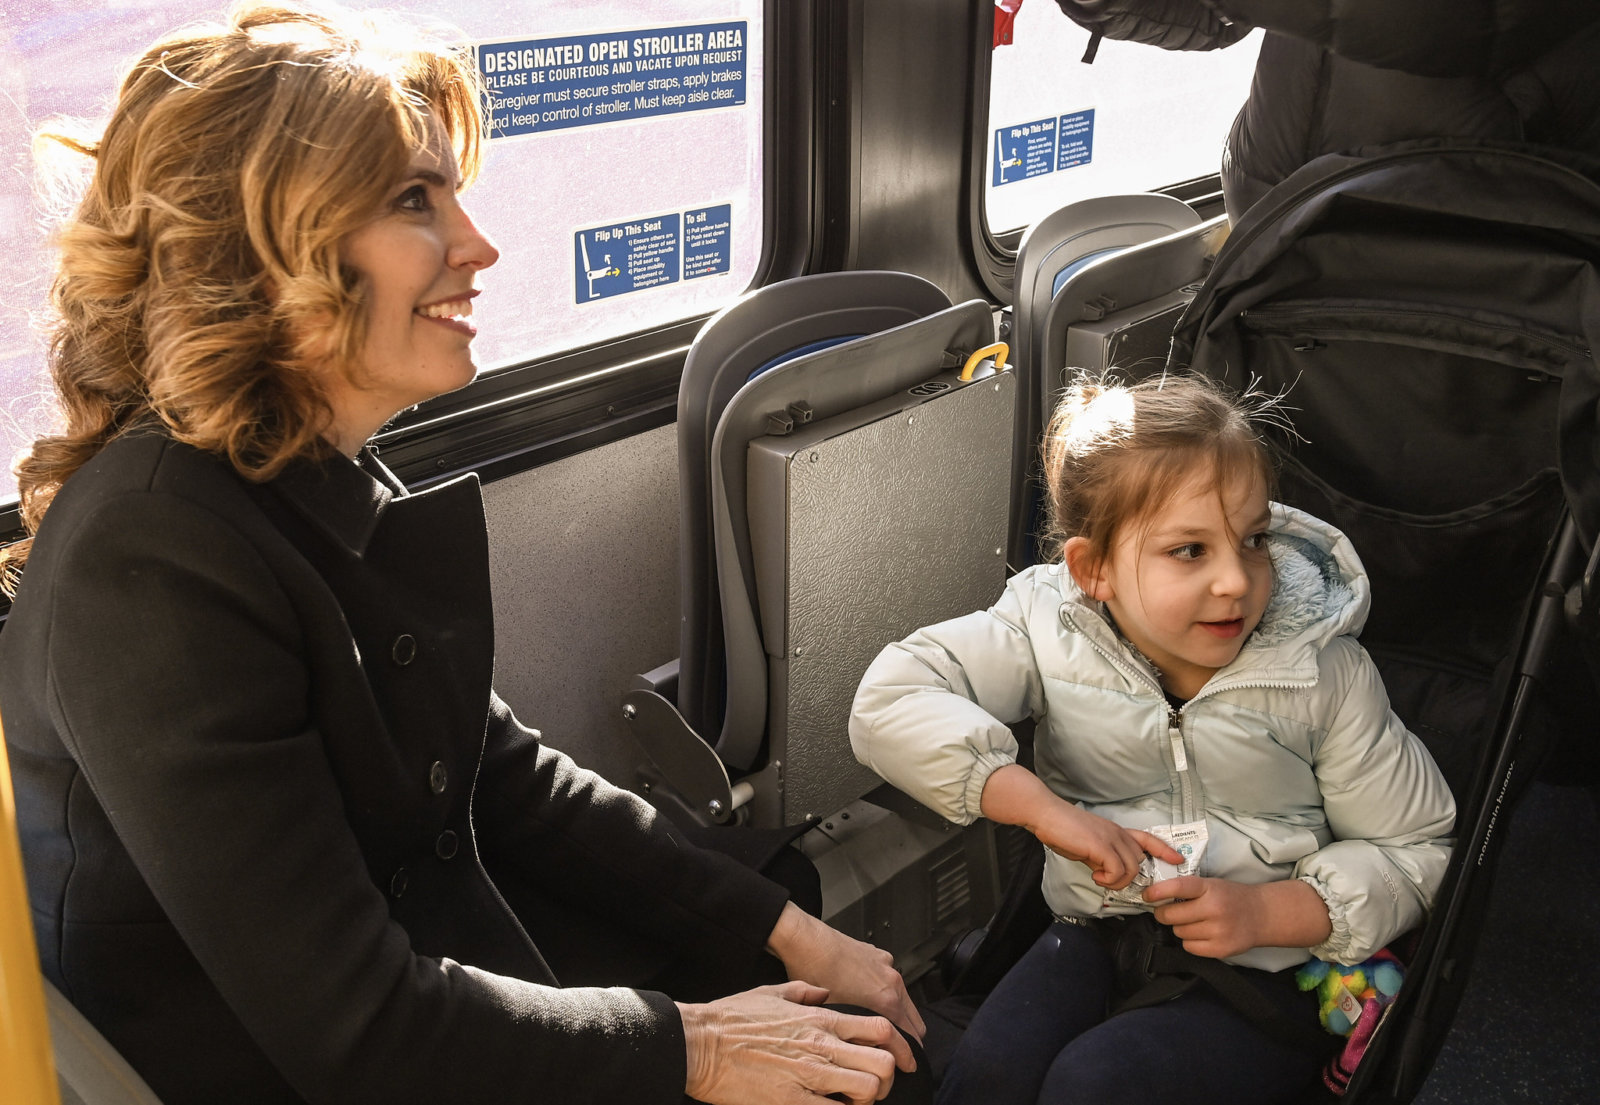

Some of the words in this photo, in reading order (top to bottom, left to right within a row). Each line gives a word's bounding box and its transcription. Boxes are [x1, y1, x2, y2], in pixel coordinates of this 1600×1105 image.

[485, 45, 583, 73] DESIGNATED
[589, 40, 628, 62] OPEN
[633, 33, 703, 57] STROLLER
[707, 29, 743, 50] AREA
[486, 73, 528, 89] PLEASE
[531, 71, 545, 84] BE
[549, 63, 609, 81] COURTEOUS
[612, 62, 632, 74] AND
[635, 57, 672, 71] VACATE
[675, 54, 699, 67] UPON
[703, 50, 742, 65] REQUEST
[488, 93, 540, 110] Caregiver
[543, 88, 570, 103] must
[573, 86, 608, 100] secure
[611, 79, 646, 95] stroller
[647, 77, 680, 91] straps,
[683, 71, 709, 89] apply
[711, 69, 742, 83] brakes
[512, 112, 539, 127] keep
[542, 104, 579, 122] control
[582, 102, 593, 117] of
[595, 99, 631, 115] stroller.
[635, 95, 659, 110] Must
[662, 94, 685, 107] keep
[688, 89, 709, 103] aisle
[711, 87, 735, 100] clear.
[1011, 129, 1021, 139] Flip
[1022, 127, 1030, 137] Up
[1030, 124, 1041, 134] This
[1042, 121, 1054, 132] Seat
[595, 230, 610, 242] Flip
[612, 228, 623, 240] Up
[624, 224, 641, 236] This
[643, 220, 662, 232] Seat
[686, 214, 695, 225] To
[696, 212, 707, 223] sit
[1478, 805, 1500, 866] mountain
